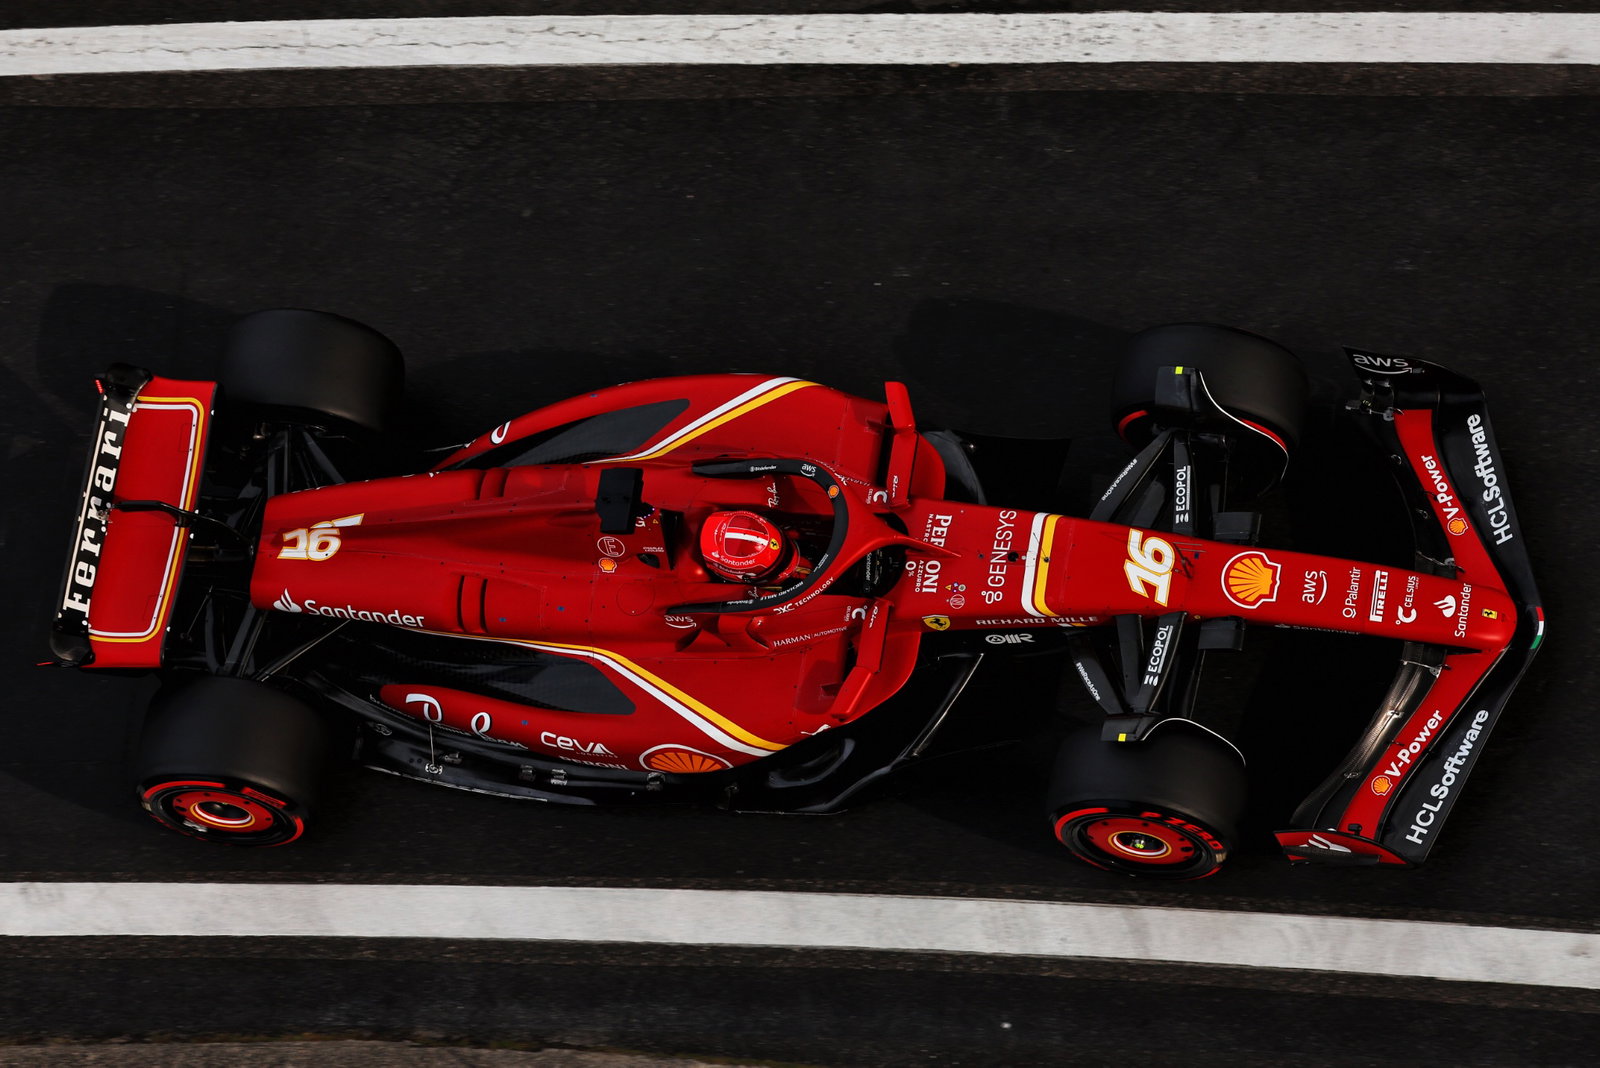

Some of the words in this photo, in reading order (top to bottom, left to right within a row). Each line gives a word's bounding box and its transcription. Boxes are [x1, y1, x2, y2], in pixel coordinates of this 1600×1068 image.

[1352, 354, 1410, 368] aws
[801, 463, 817, 473] aws
[1175, 466, 1187, 513] ECOPOL
[1421, 454, 1460, 520] V-Power
[1466, 412, 1514, 545] HCLSoftware
[62, 402, 135, 616] Ferrari
[275, 512, 365, 562] 16
[988, 509, 1017, 588] GENESYS
[720, 554, 756, 566] Santander
[914, 559, 926, 593] AZZURRO
[1122, 528, 1176, 607] 16
[795, 576, 835, 607] TECHNOLOGY
[1302, 571, 1318, 604] aws
[1346, 566, 1361, 608] Palantir
[1369, 570, 1389, 623] PIRELLI
[1404, 575, 1416, 607] CELSIUS
[303, 600, 425, 628] Santander
[665, 614, 693, 624] aws
[976, 616, 1046, 626] RICHARD
[1050, 614, 1099, 624] MILLE
[1455, 583, 1472, 638] Santander
[773, 633, 812, 648] HARMAN
[813, 626, 848, 639] AUTOMOTIVE
[1147, 624, 1171, 675] ECOPOL
[1384, 709, 1443, 778] V-Power
[1405, 708, 1490, 845] HCLSoftware
